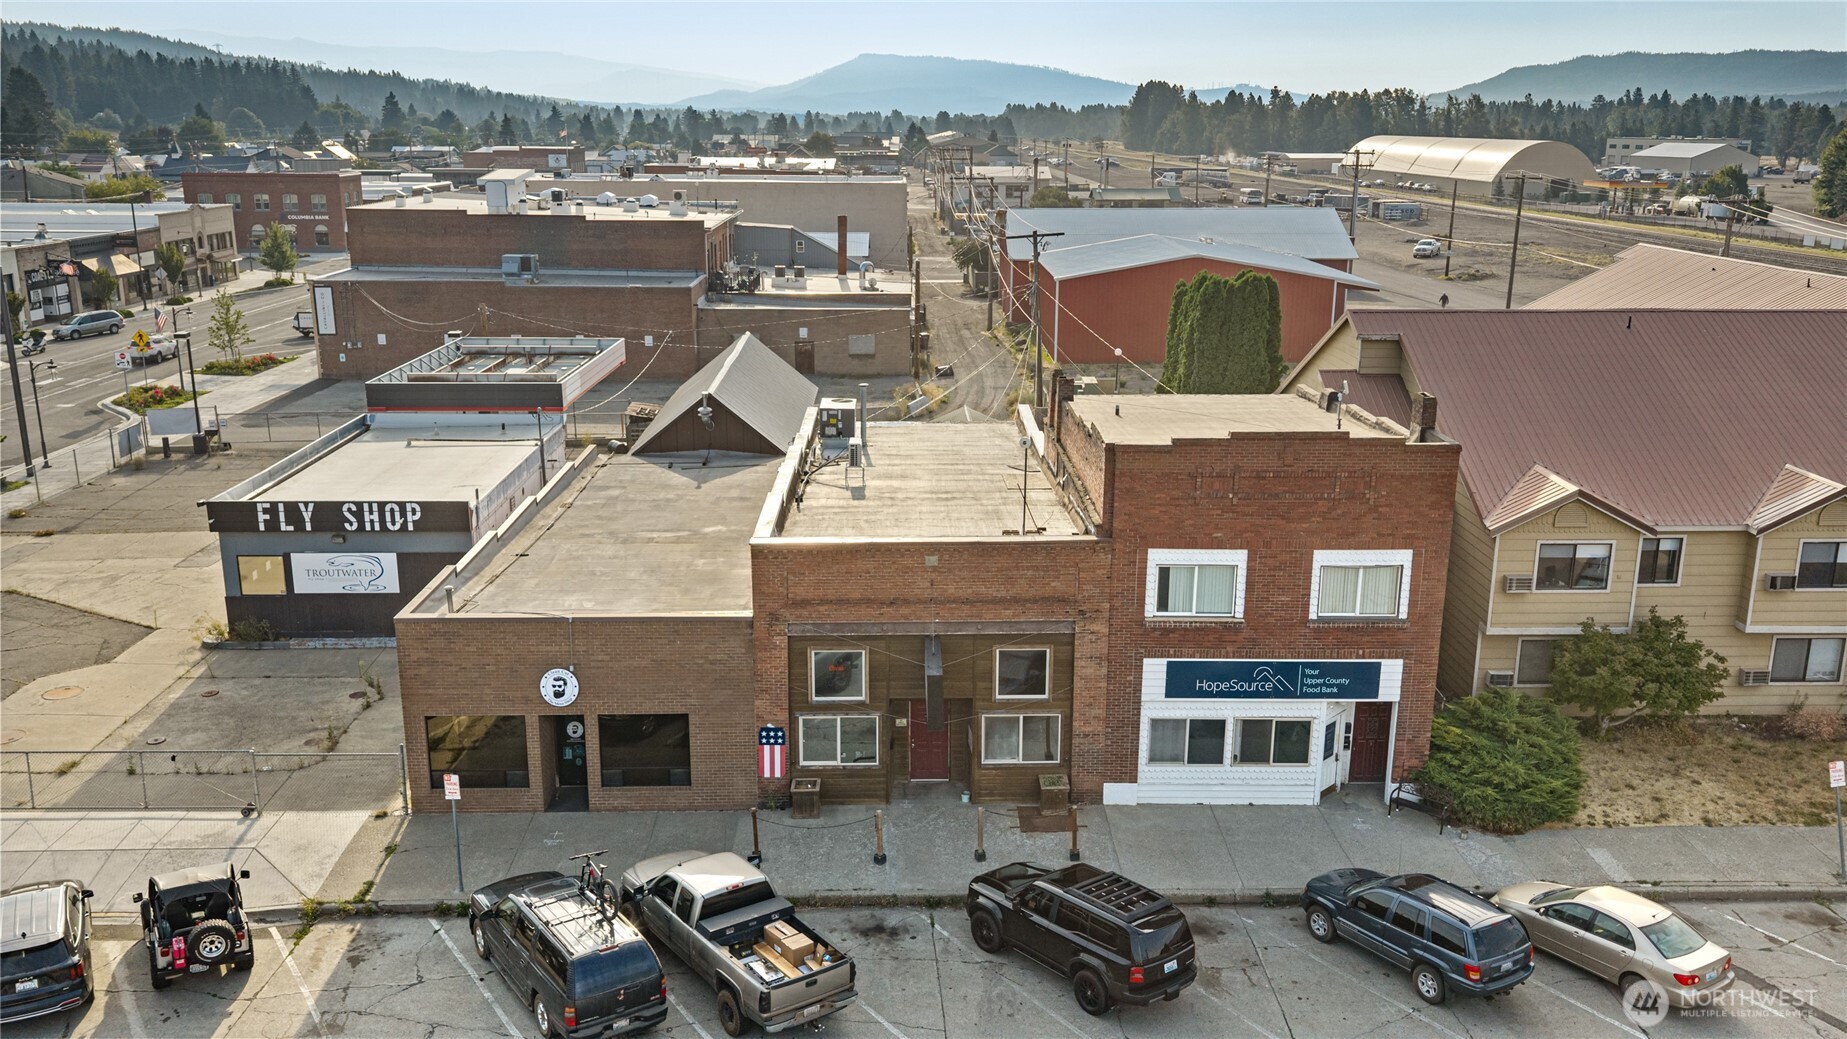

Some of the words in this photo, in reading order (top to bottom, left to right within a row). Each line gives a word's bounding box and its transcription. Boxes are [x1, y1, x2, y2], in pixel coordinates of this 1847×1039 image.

[256, 502, 315, 532] FLY
[342, 502, 422, 532] SHOP
[305, 568, 377, 578] TROUTWATER
[1196, 679, 1273, 694] HopeSource
[1303, 677, 1324, 685] Upper
[1325, 677, 1350, 686] County
